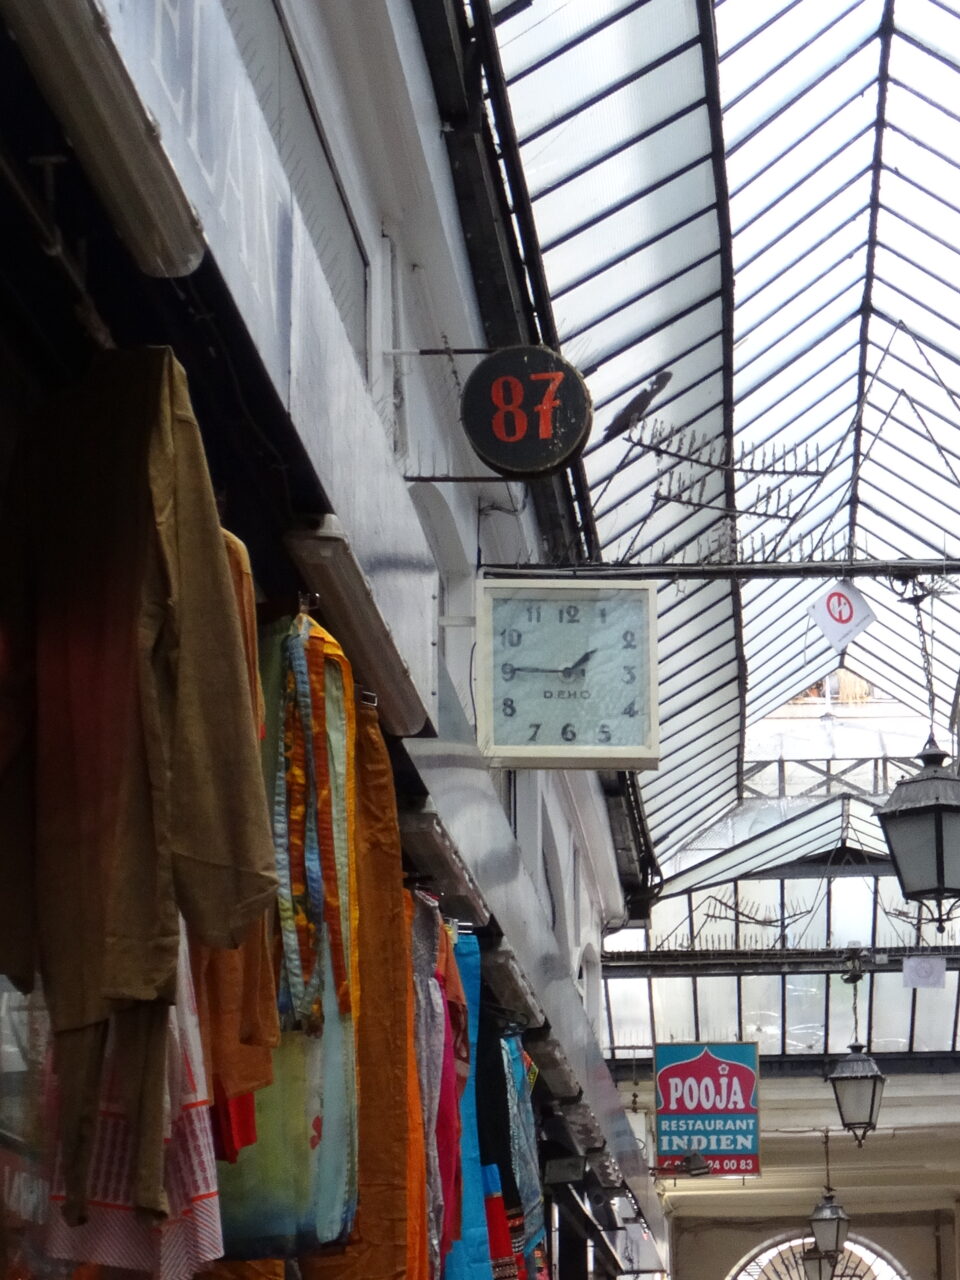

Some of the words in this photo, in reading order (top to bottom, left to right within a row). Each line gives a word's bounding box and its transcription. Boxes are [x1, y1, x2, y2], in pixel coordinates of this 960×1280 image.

[490, 371, 566, 443] 87
[558, 605, 580, 624] 12
[500, 628, 523, 648] 10
[621, 630, 637, 650] 2
[501, 662, 517, 682] 9
[621, 665, 637, 685] 3
[502, 697, 517, 718] 8
[621, 700, 639, 718] 4
[527, 723, 542, 742] 7
[560, 722, 577, 742] 6
[598, 723, 612, 743] 5
[668, 1075, 746, 1111] POOJA
[661, 1119, 756, 1132] RESTAURANT
[660, 1134, 754, 1151] INDIEN
